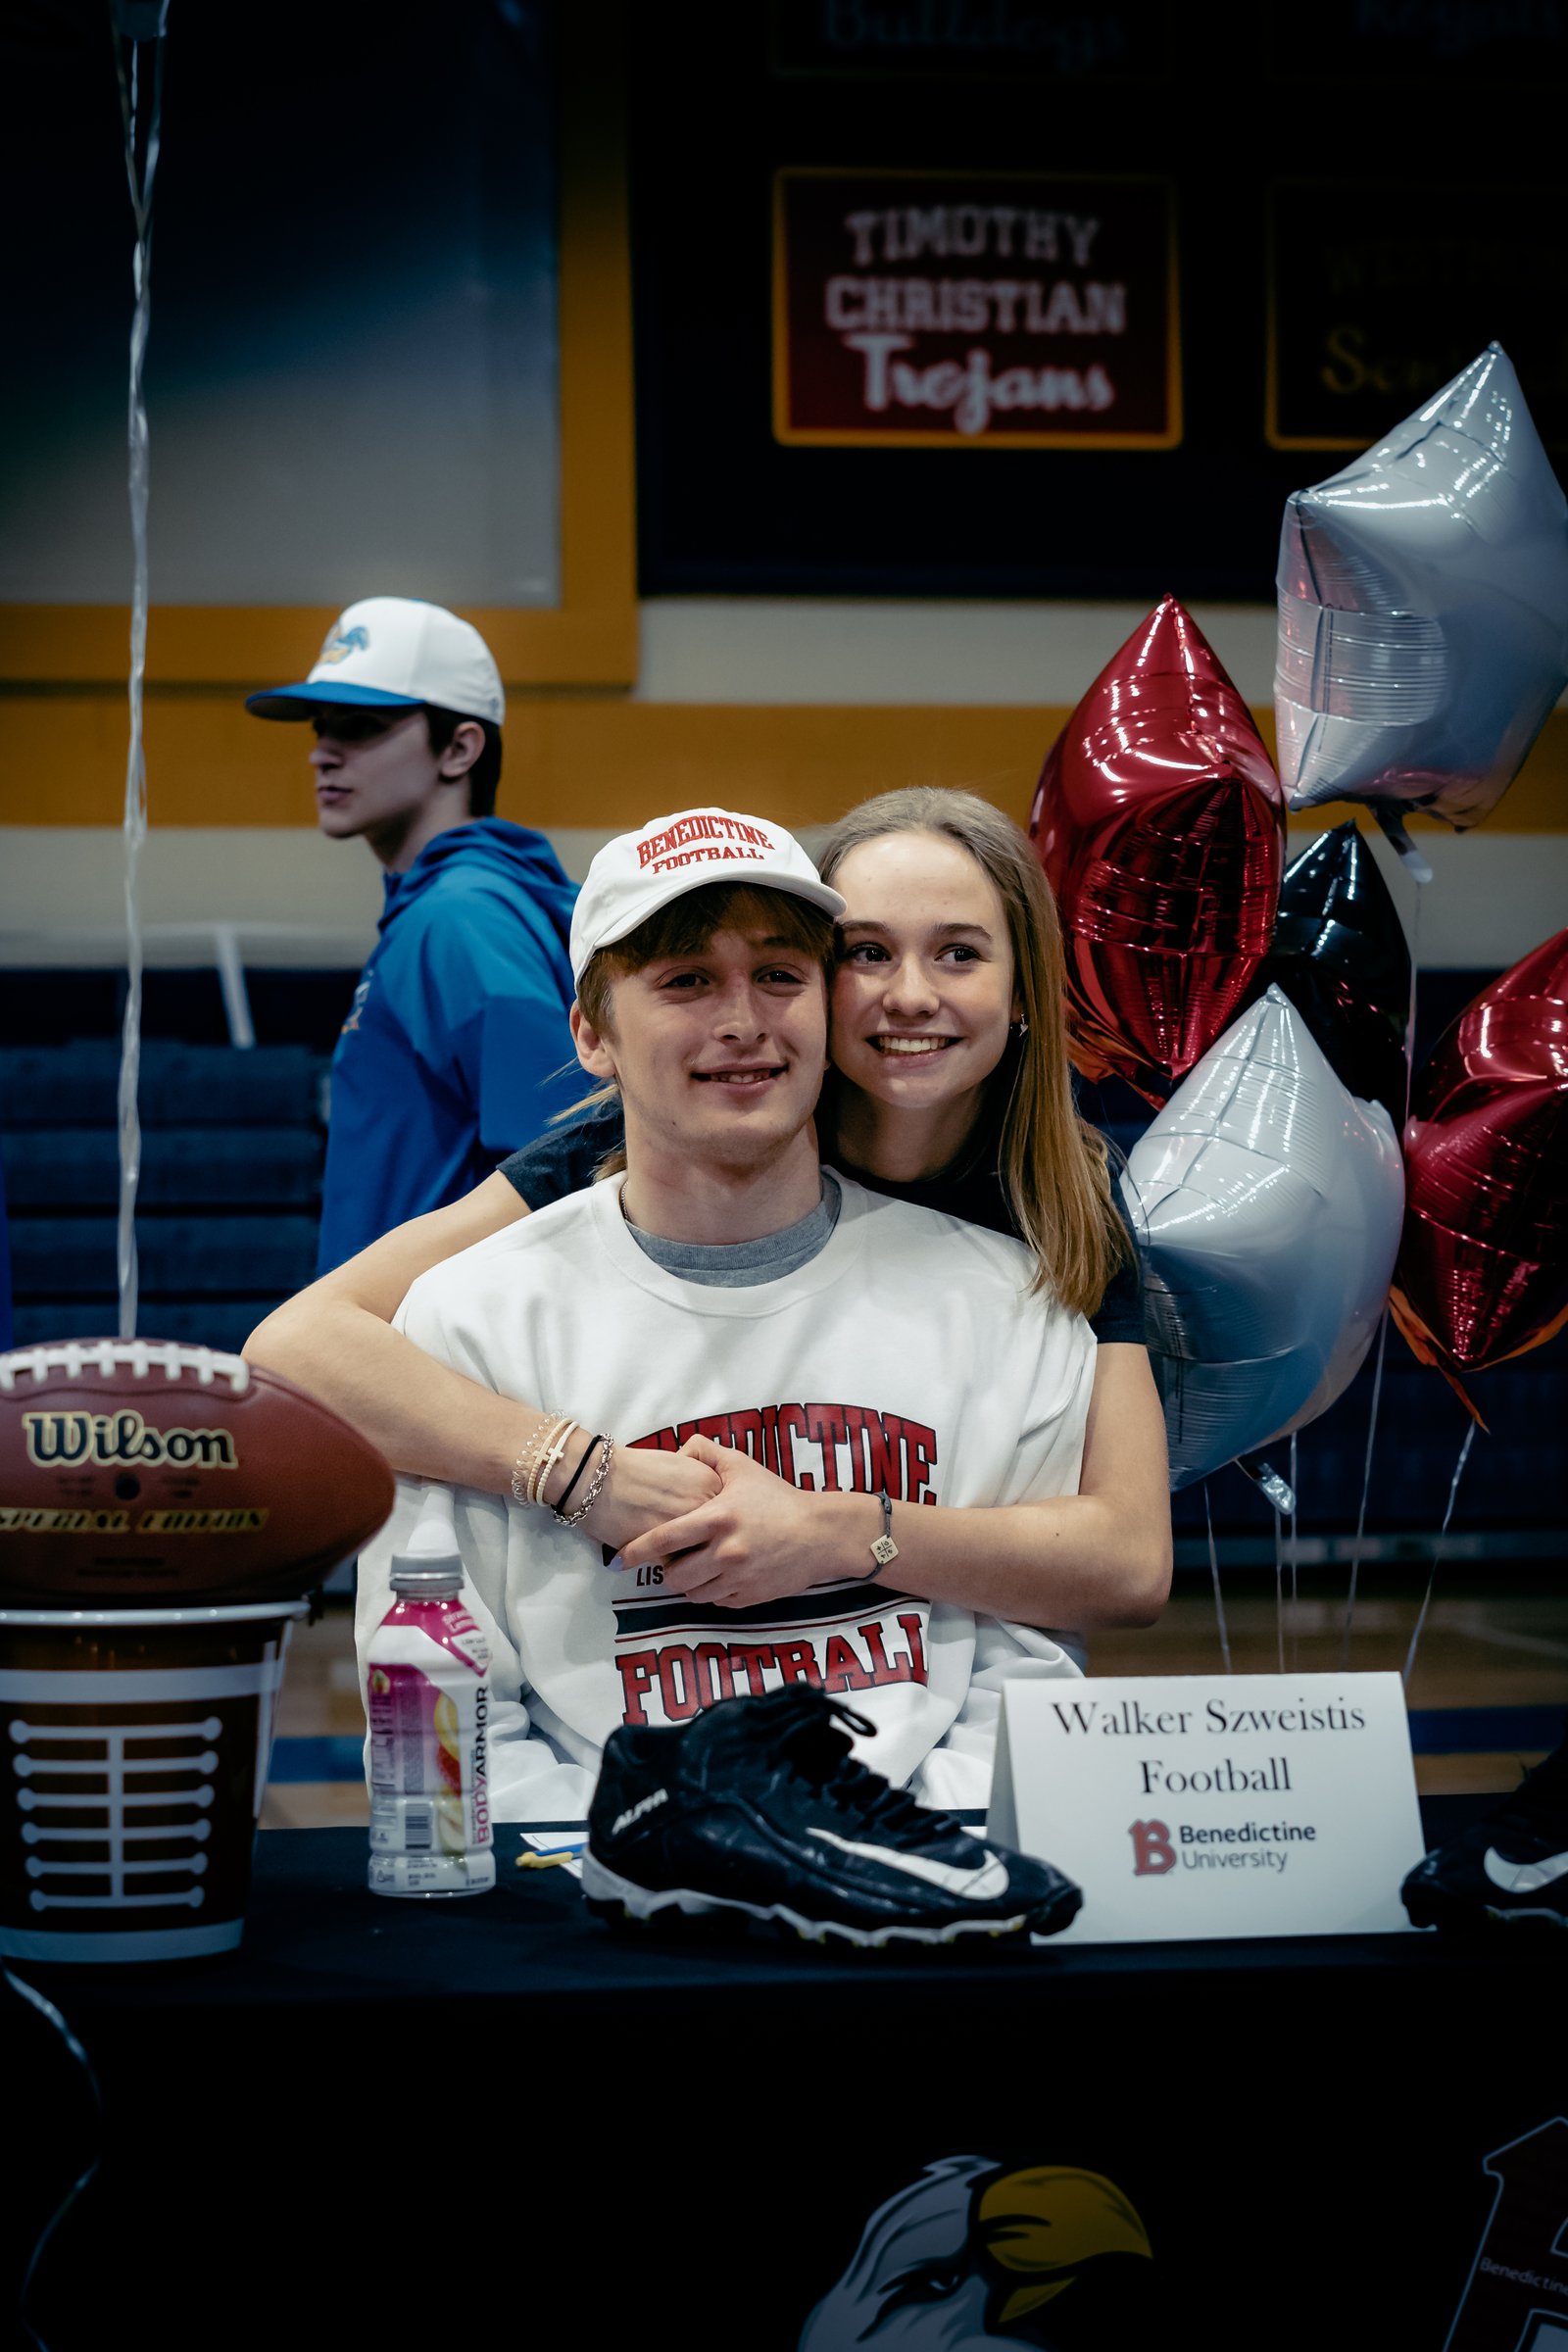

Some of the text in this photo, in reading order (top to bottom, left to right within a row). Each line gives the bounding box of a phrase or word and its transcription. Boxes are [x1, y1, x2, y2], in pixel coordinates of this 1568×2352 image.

[845, 202, 1104, 269] TIMOTHY
[823, 272, 1129, 337] CHRISTIAN
[841, 331, 1115, 437] Trojans
[637, 815, 775, 869] BENEDICTINE
[653, 847, 764, 874] FOOTBALL
[22, 1409, 238, 1469] Wilson
[614, 1613, 928, 1726] FOOTBALL
[1051, 1697, 1366, 1736] Walker Szweistis
[474, 1685, 490, 1844] BODYARMOR
[1138, 1757, 1293, 1793] Football
[1180, 1822, 1316, 1844] Benedictine
[1182, 1847, 1289, 1873] University
